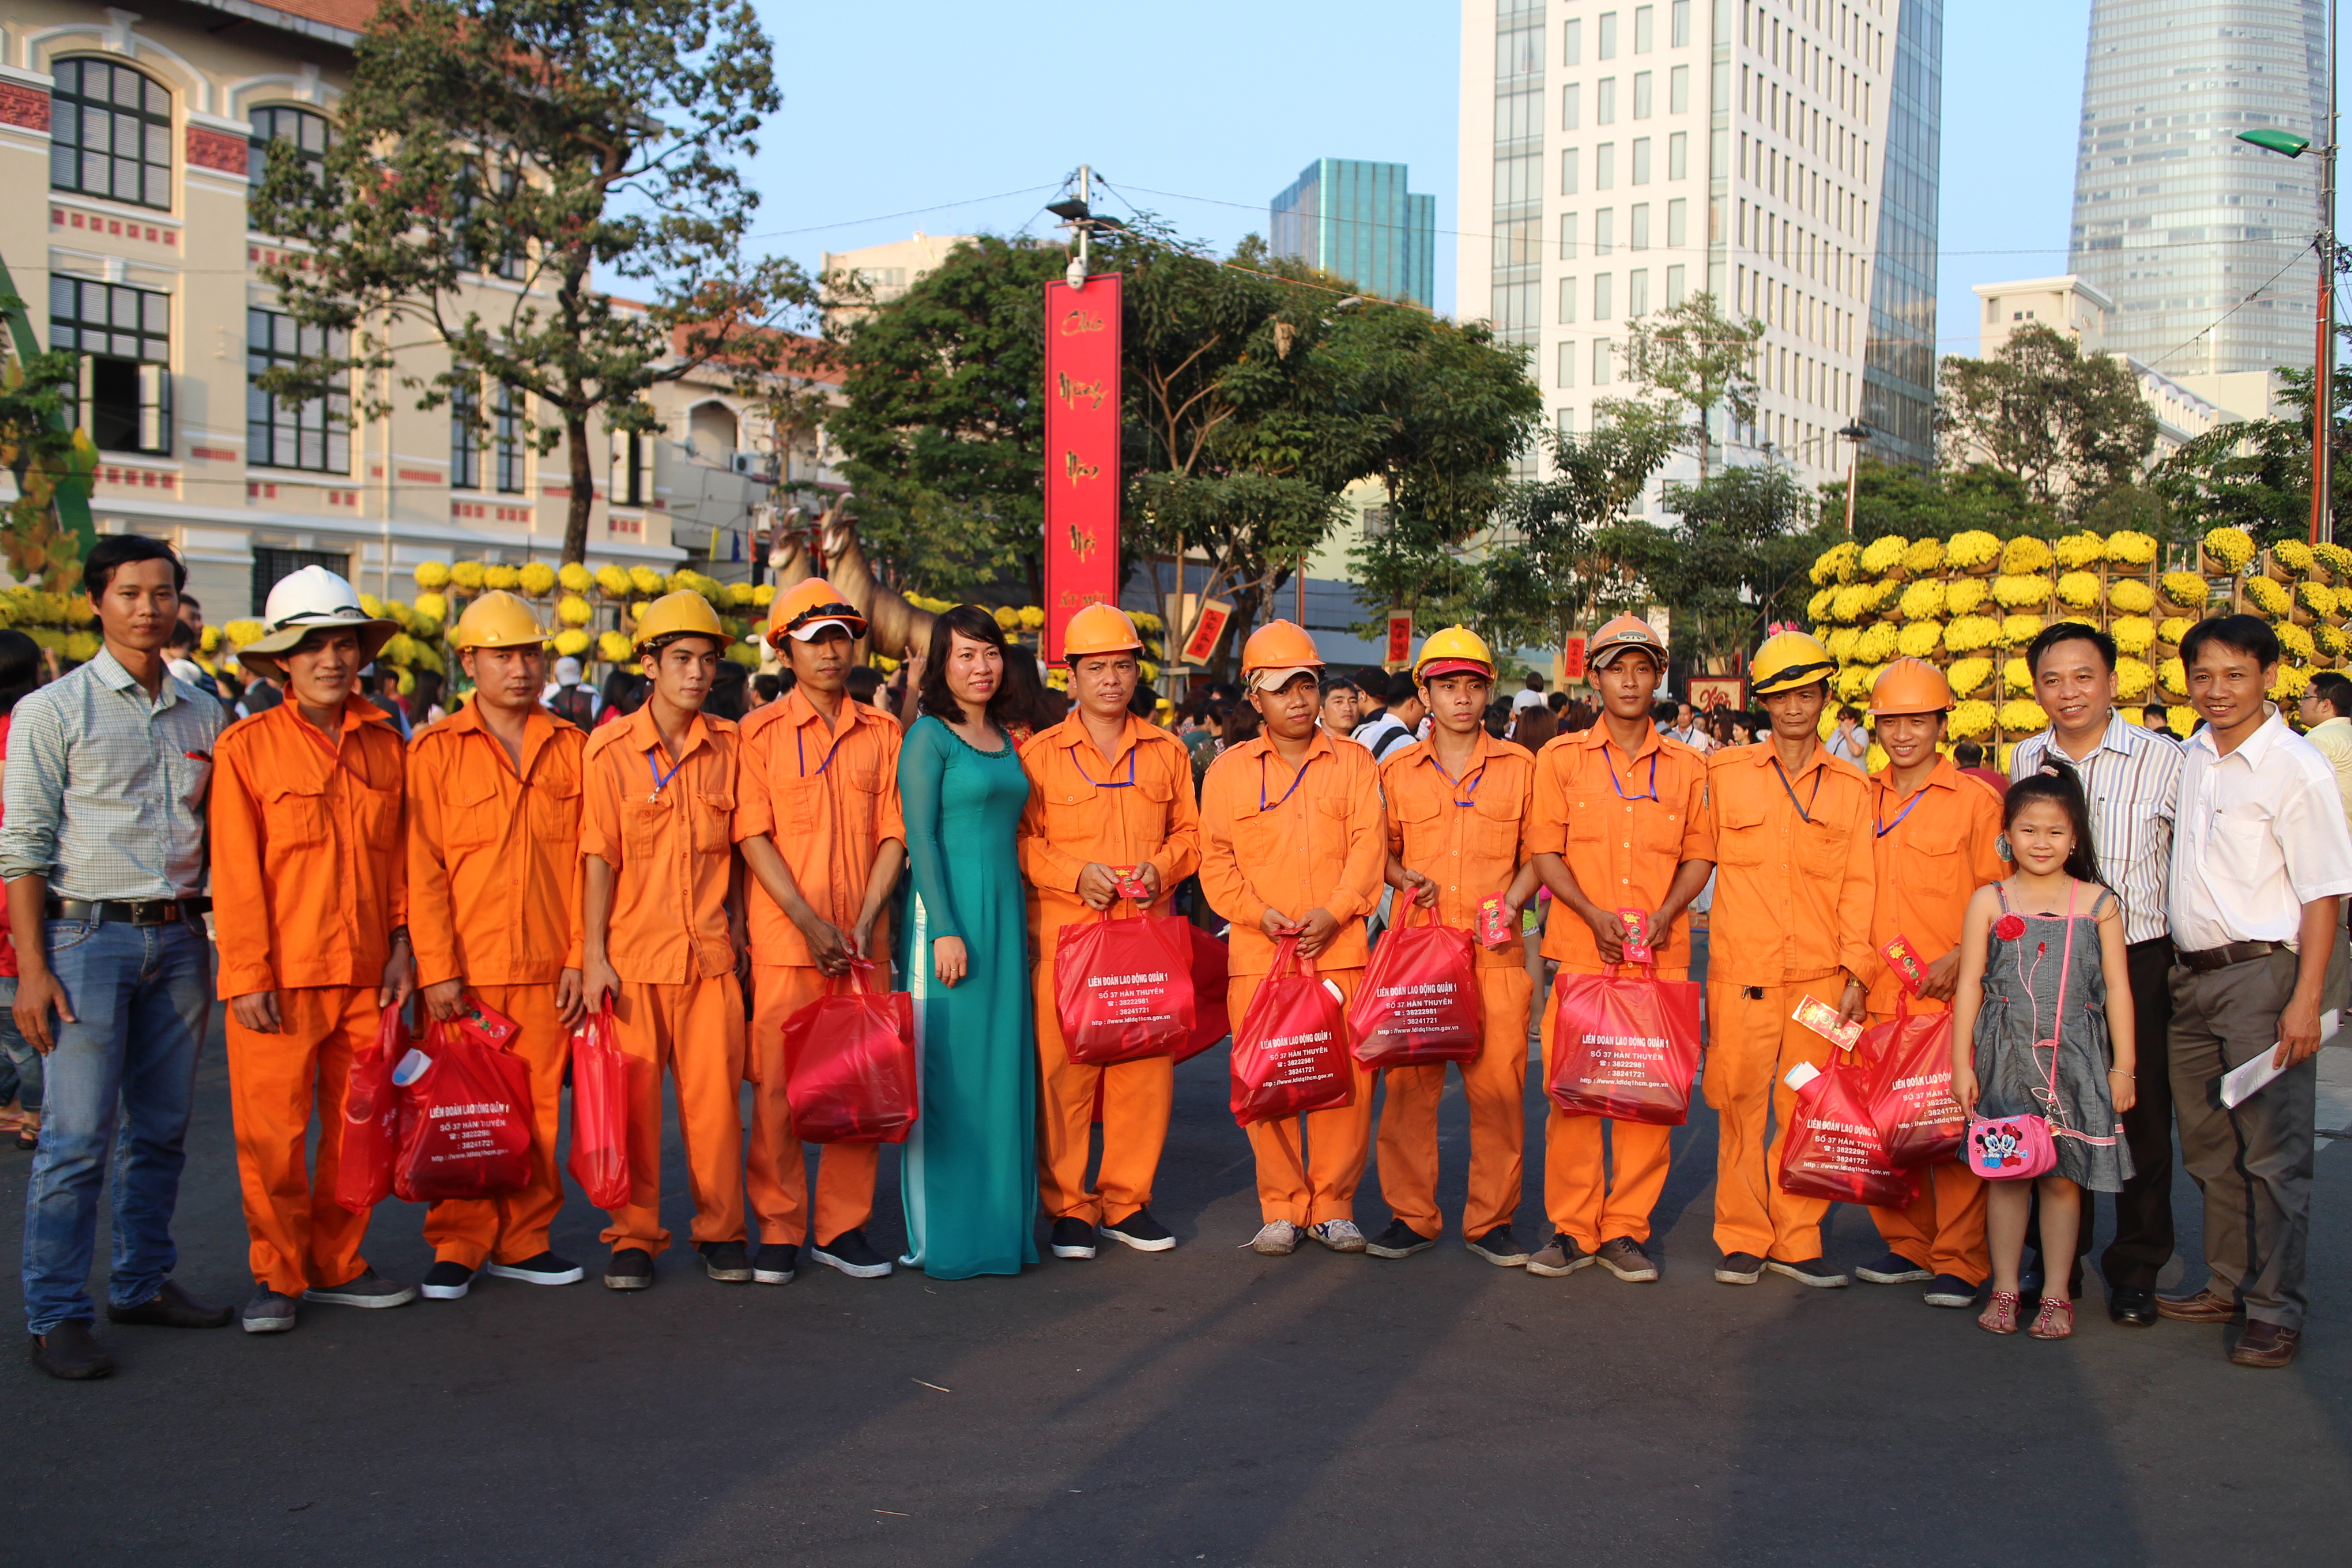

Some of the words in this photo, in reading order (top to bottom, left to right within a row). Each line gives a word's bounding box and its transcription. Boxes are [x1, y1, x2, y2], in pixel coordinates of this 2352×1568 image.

[1088, 976, 1102, 987] LIÊN
[1102, 974, 1119, 985] ĐOÀN
[1120, 975, 1130, 984] LAO
[1131, 973, 1147, 985] ĐỘNG
[1148, 971, 1164, 984] QUẬN
[1164, 973, 1169, 981] 1
[1098, 990, 1109, 999] SỐ
[1136, 987, 1164, 996] THUYÊN
[1377, 986, 1389, 998] LIÊN
[1390, 984, 1406, 996] ĐOÀN
[1407, 985, 1418, 995] LAO
[1419, 983, 1435, 996] ĐỘNG
[1437, 981, 1452, 995] QUẬN
[1454, 983, 1457, 992] 1
[1119, 998, 1149, 1006] 38222981
[1386, 1000, 1396, 1009] SỐ
[1424, 998, 1452, 1006] THUYÊN
[1273, 1035, 1288, 1047] ĐOÀN
[1289, 1036, 1298, 1045] LAO
[1299, 1032, 1313, 1045] ĐỘNG
[1314, 1030, 1328, 1043] QUẬN
[1329, 1031, 1332, 1040] 1
[1582, 1032, 1595, 1044] LIÊN
[1597, 1033, 1614, 1045] ĐOÀN
[1615, 1036, 1627, 1046] LAO
[1629, 1035, 1646, 1049] ĐỘNG
[1647, 1036, 1664, 1050] QUẬN
[1665, 1039, 1669, 1048] 1
[1270, 1051, 1279, 1060] SỐ
[1303, 1046, 1328, 1056] THUYÊN
[1590, 1049, 1601, 1058] SỐ
[1288, 1057, 1314, 1066] 38222981
[1288, 1066, 1314, 1075] 38241721
[1892, 1079, 1906, 1091] LIÊN
[1906, 1075, 1924, 1088] ĐOÀN
[1925, 1075, 1937, 1085] LAO
[1938, 1071, 1952, 1085] ĐỘN
[1903, 1092, 1914, 1101] SỐ
[1926, 1090, 1943, 1098] HÀN
[463, 1103, 475, 1115] LAO
[1928, 1106, 1961, 1116] 38241721
[1807, 1117, 1821, 1130] LIÊN
[1823, 1120, 1840, 1131] ĐOÀN
[1841, 1123, 1853, 1133] LAO
[1855, 1124, 1871, 1137] ĐỘNG
[1836, 1147, 1869, 1156] 38222981
[1857, 1141, 1882, 1151] THUYÊ
[1836, 1156, 1868, 1165] 38241721
